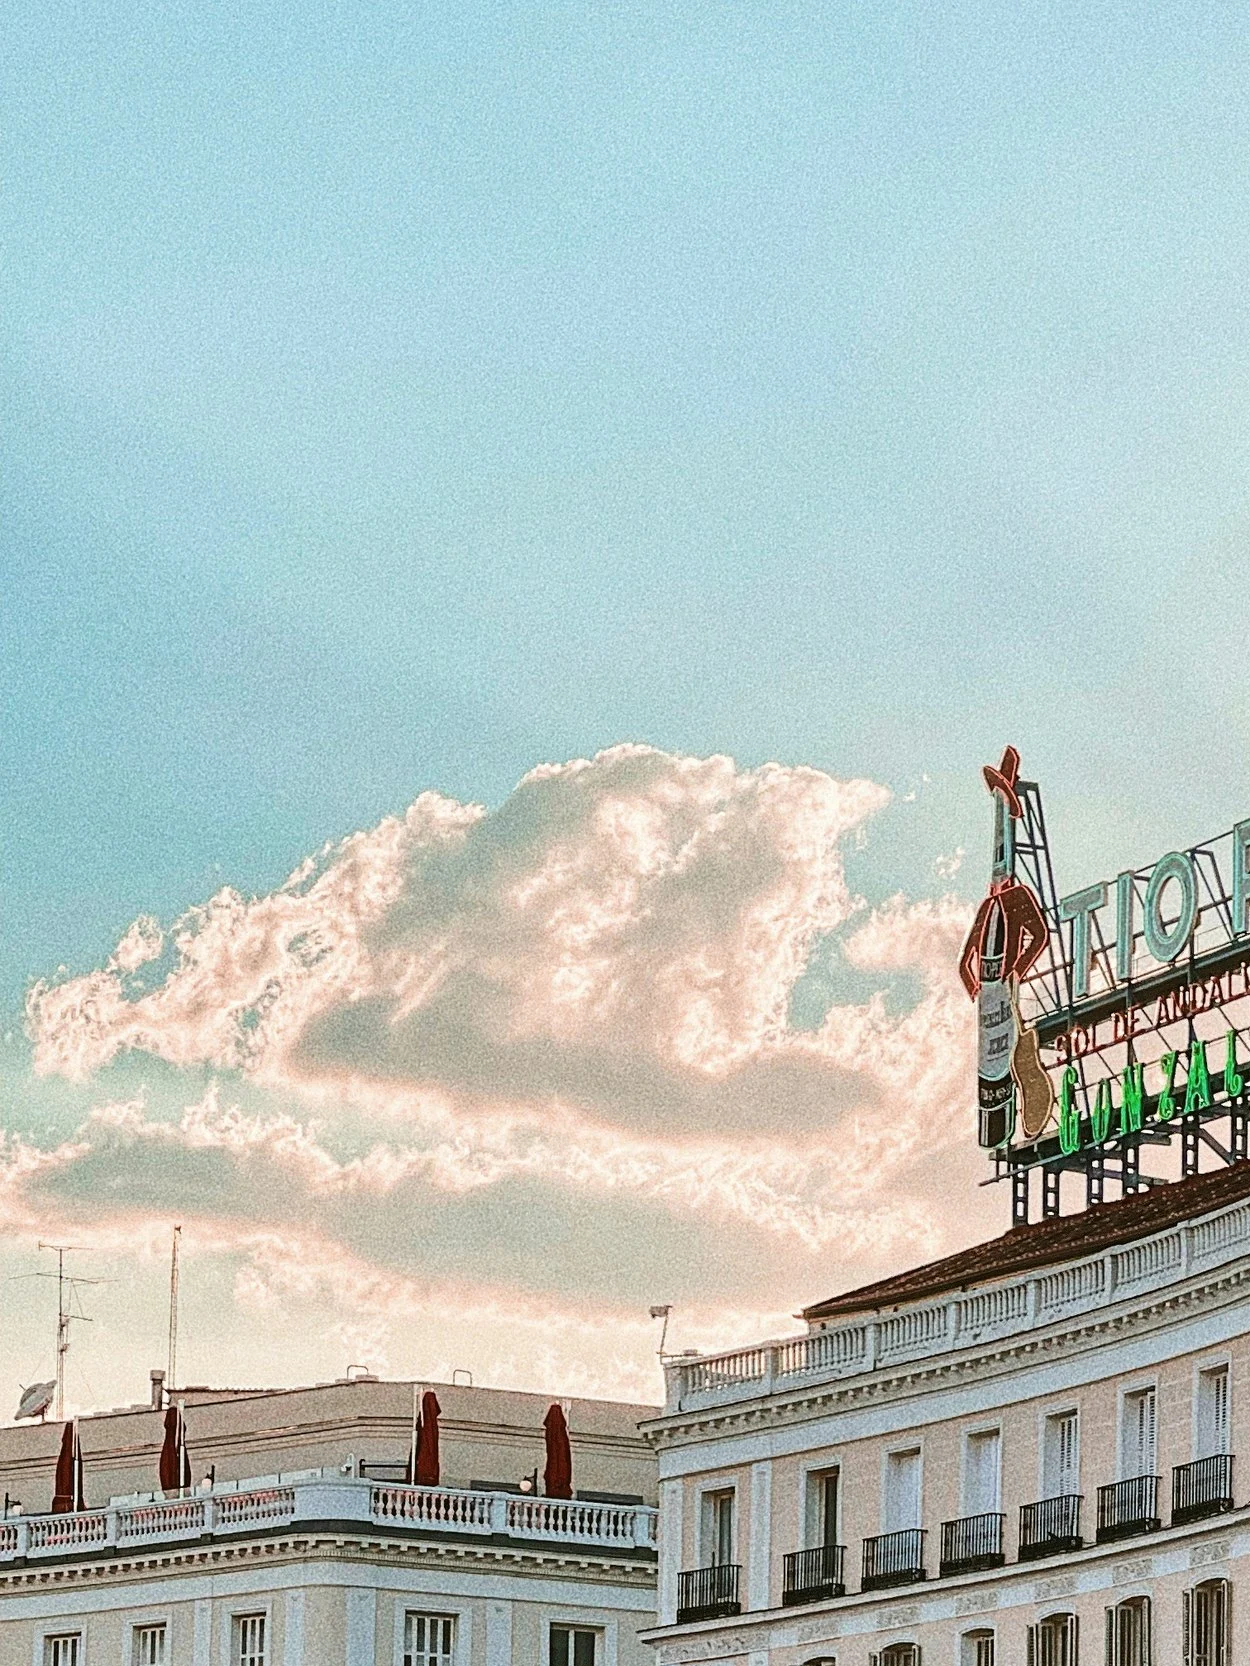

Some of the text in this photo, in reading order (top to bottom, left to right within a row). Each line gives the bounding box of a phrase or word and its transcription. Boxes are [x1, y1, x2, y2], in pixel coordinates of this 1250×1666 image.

[1059, 850, 1200, 998] TIO
[1054, 1022, 1105, 1064] SOL
[1111, 1003, 1145, 1041] DE
